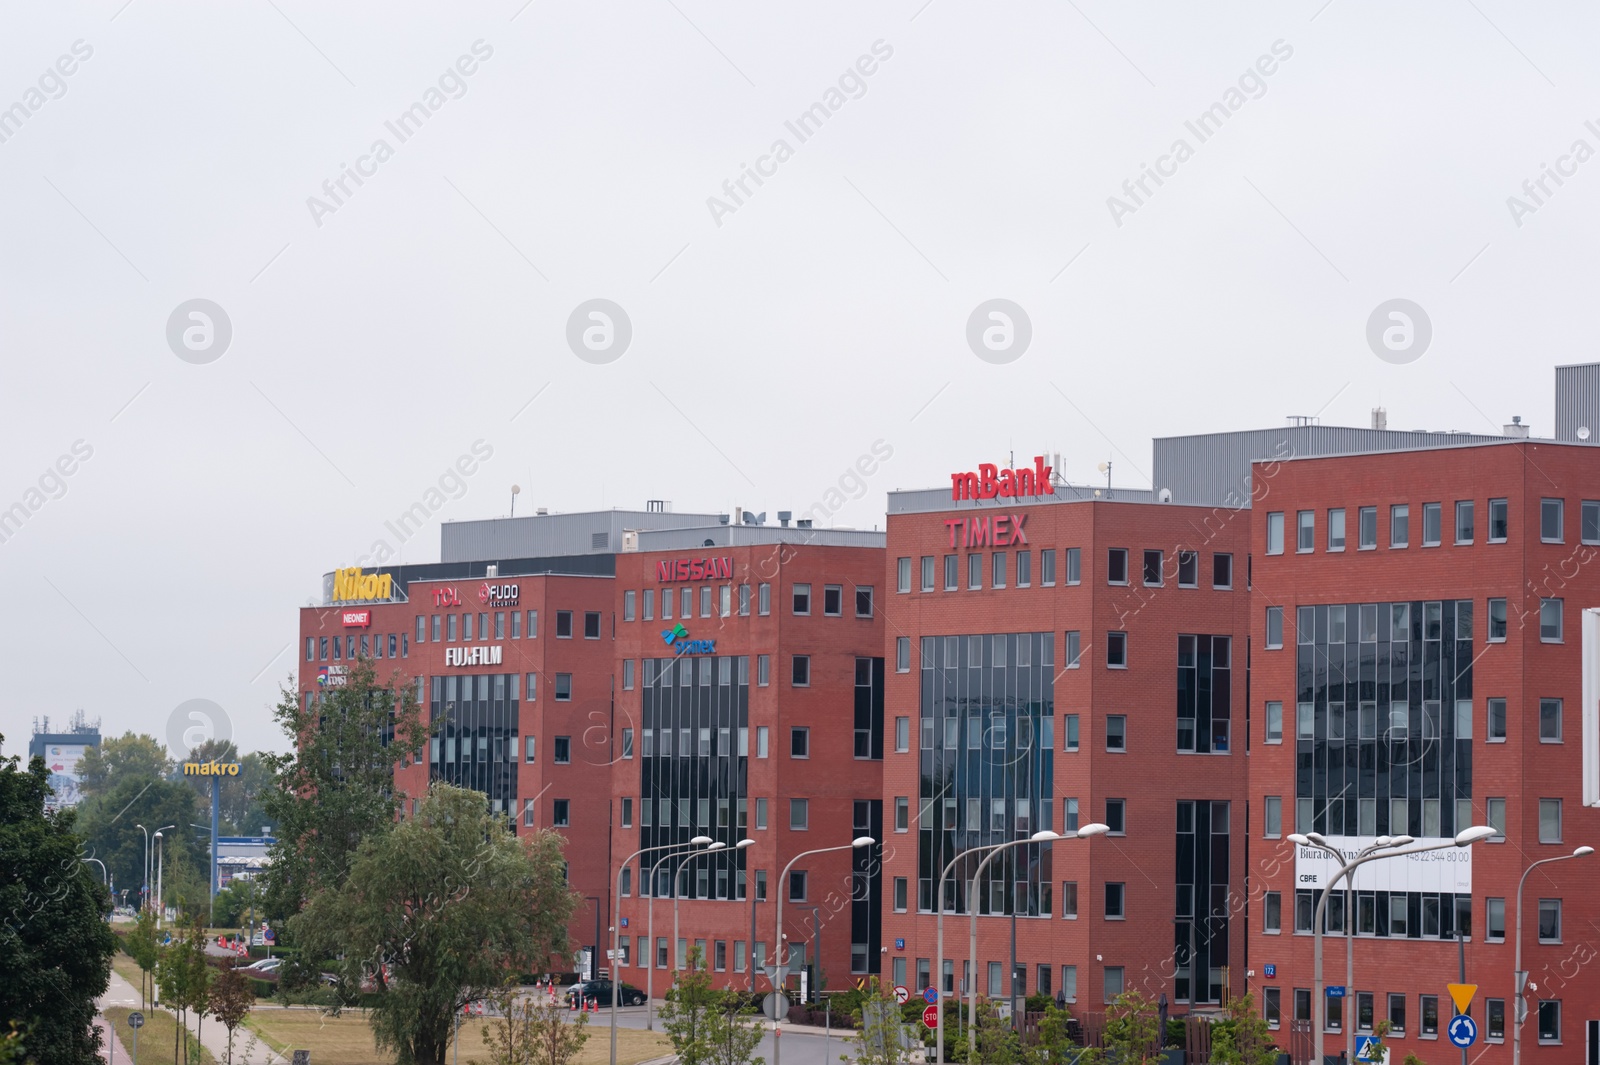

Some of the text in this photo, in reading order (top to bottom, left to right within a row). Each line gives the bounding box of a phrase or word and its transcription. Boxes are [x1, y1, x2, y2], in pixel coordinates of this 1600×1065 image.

[951, 456, 1054, 501] mBank
[943, 513, 1028, 549] TIMEX
[656, 557, 733, 583] NISSAN
[332, 566, 391, 602] Nikon
[432, 587, 461, 608] TCL
[490, 585, 518, 600] FUDO
[343, 612, 368, 623] NEONET
[446, 645, 503, 667] FUJIFILM
[184, 760, 239, 776] makro
[1300, 848, 1321, 859] Biura
[1323, 848, 1334, 859] do
[1420, 851, 1430, 862] 22
[1431, 851, 1445, 861] 544
[1446, 852, 1457, 862] 80
[1458, 852, 1469, 862] 00
[1299, 874, 1318, 883] CBRE
[1265, 967, 1274, 975] 172
[925, 1013, 937, 1021] STO
